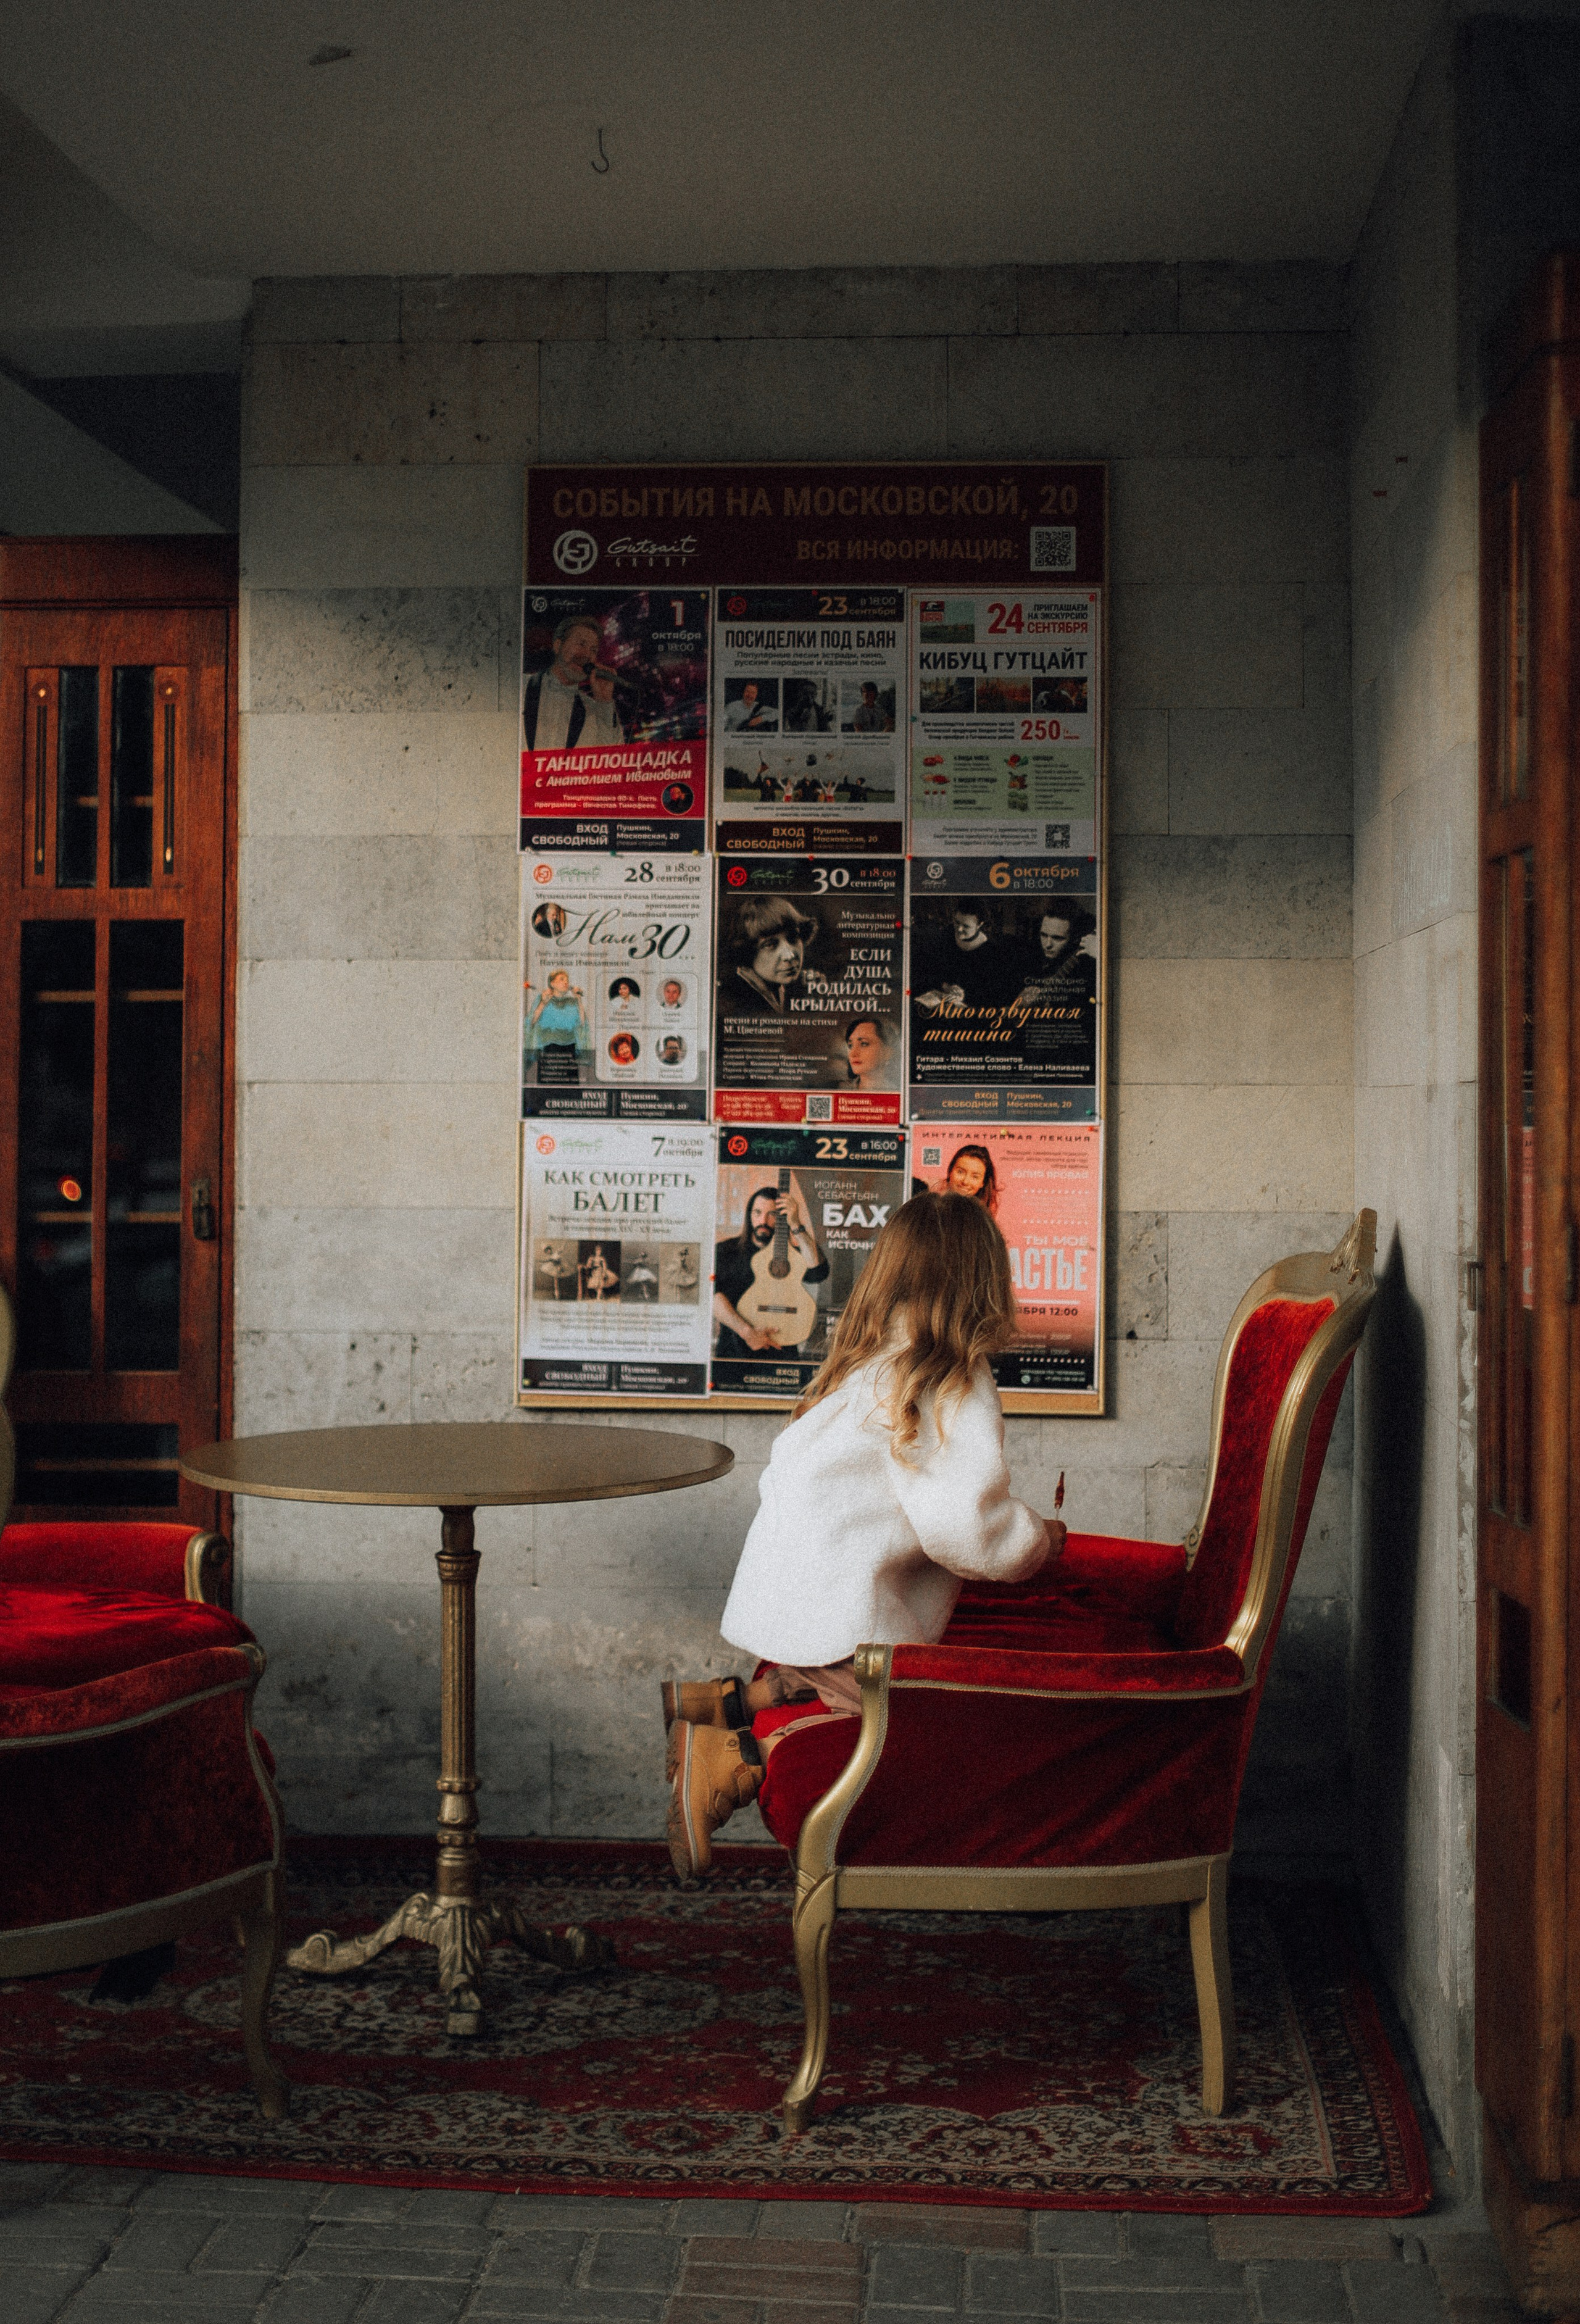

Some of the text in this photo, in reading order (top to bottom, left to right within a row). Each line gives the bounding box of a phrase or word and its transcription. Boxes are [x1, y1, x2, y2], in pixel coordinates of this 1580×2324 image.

[553, 477, 1079, 521] СОБЫТИЯ НА МОСКОВСКОЙ, 20
[607, 535, 697, 554] Gutsait
[796, 539, 1020, 563] ВСЯ ИНФОРМАЦИЯ:
[615, 557, 687, 567] GROUP
[818, 596, 849, 615] 23
[670, 599, 684, 627] 1
[988, 603, 1025, 634] 24
[1028, 622, 1088, 633] СЕНТЯБРЯ
[652, 630, 702, 641] октября
[725, 630, 896, 650] ПОСИДЕЛКИ ПОД БАЯН
[920, 648, 1087, 673] КИБУЦ ГУТЦАЙТ
[1021, 720, 1060, 740] 250
[534, 749, 692, 773] ТАНЦПЛОЩАДКА
[535, 770, 692, 788] с Анатолием Ивановым
[576, 823, 609, 835] ВХОД
[617, 824, 652, 833] Пушкин,
[772, 827, 805, 838] ВХОД
[813, 827, 850, 835] Пушкин,
[531, 835, 609, 846] СВОБОДНЫЙ
[617, 833, 668, 841] Московская,
[726, 838, 805, 849] СВОБОДНЫЙ
[625, 862, 654, 883] 28
[989, 861, 1079, 889] 6 октября
[655, 875, 701, 883] сентября
[811, 867, 850, 894] 30
[850, 880, 896, 889] сентября
[841, 910, 895, 920] Музыкально
[836, 922, 894, 931] литературная
[628, 923, 690, 959] 30
[850, 948, 891, 961] ЕСЛИ
[844, 965, 892, 979] ДУША
[807, 981, 891, 996] РОДИЛАСЬ
[790, 997, 891, 1012] КРЫЛАТОЙ...
[919, 996, 1085, 1029] Многозвучная
[759, 1018, 798, 1027] романсы
[739, 1026, 783, 1035] Цветаевой
[923, 1029, 1016, 1042] тишина
[975, 1092, 999, 1100] ВХОД
[1007, 1092, 1044, 1100] Пушкин,
[942, 1100, 999, 1109] СВОБОДНЫЙ
[1007, 1101, 1060, 1109] Московская,
[652, 1136, 665, 1157] 7
[815, 1137, 849, 1160] 23
[849, 1152, 896, 1162] сентября
[544, 1170, 696, 1188] КАК СМОТРЕТЬ
[814, 1180, 857, 1189] ИОГАНН
[573, 1191, 665, 1212] БАЛЕТ
[818, 1191, 878, 1201] СЕБАСТЬЯН
[822, 1203, 891, 1228] БАХ
[826, 1230, 849, 1239] КАК
[1025, 1235, 1047, 1245] ТЫ
[828, 1240, 876, 1251] ИСТОЧН
[1009, 1247, 1087, 1291] АСТЬЕ
[1050, 1307, 1078, 1316] 12:00
